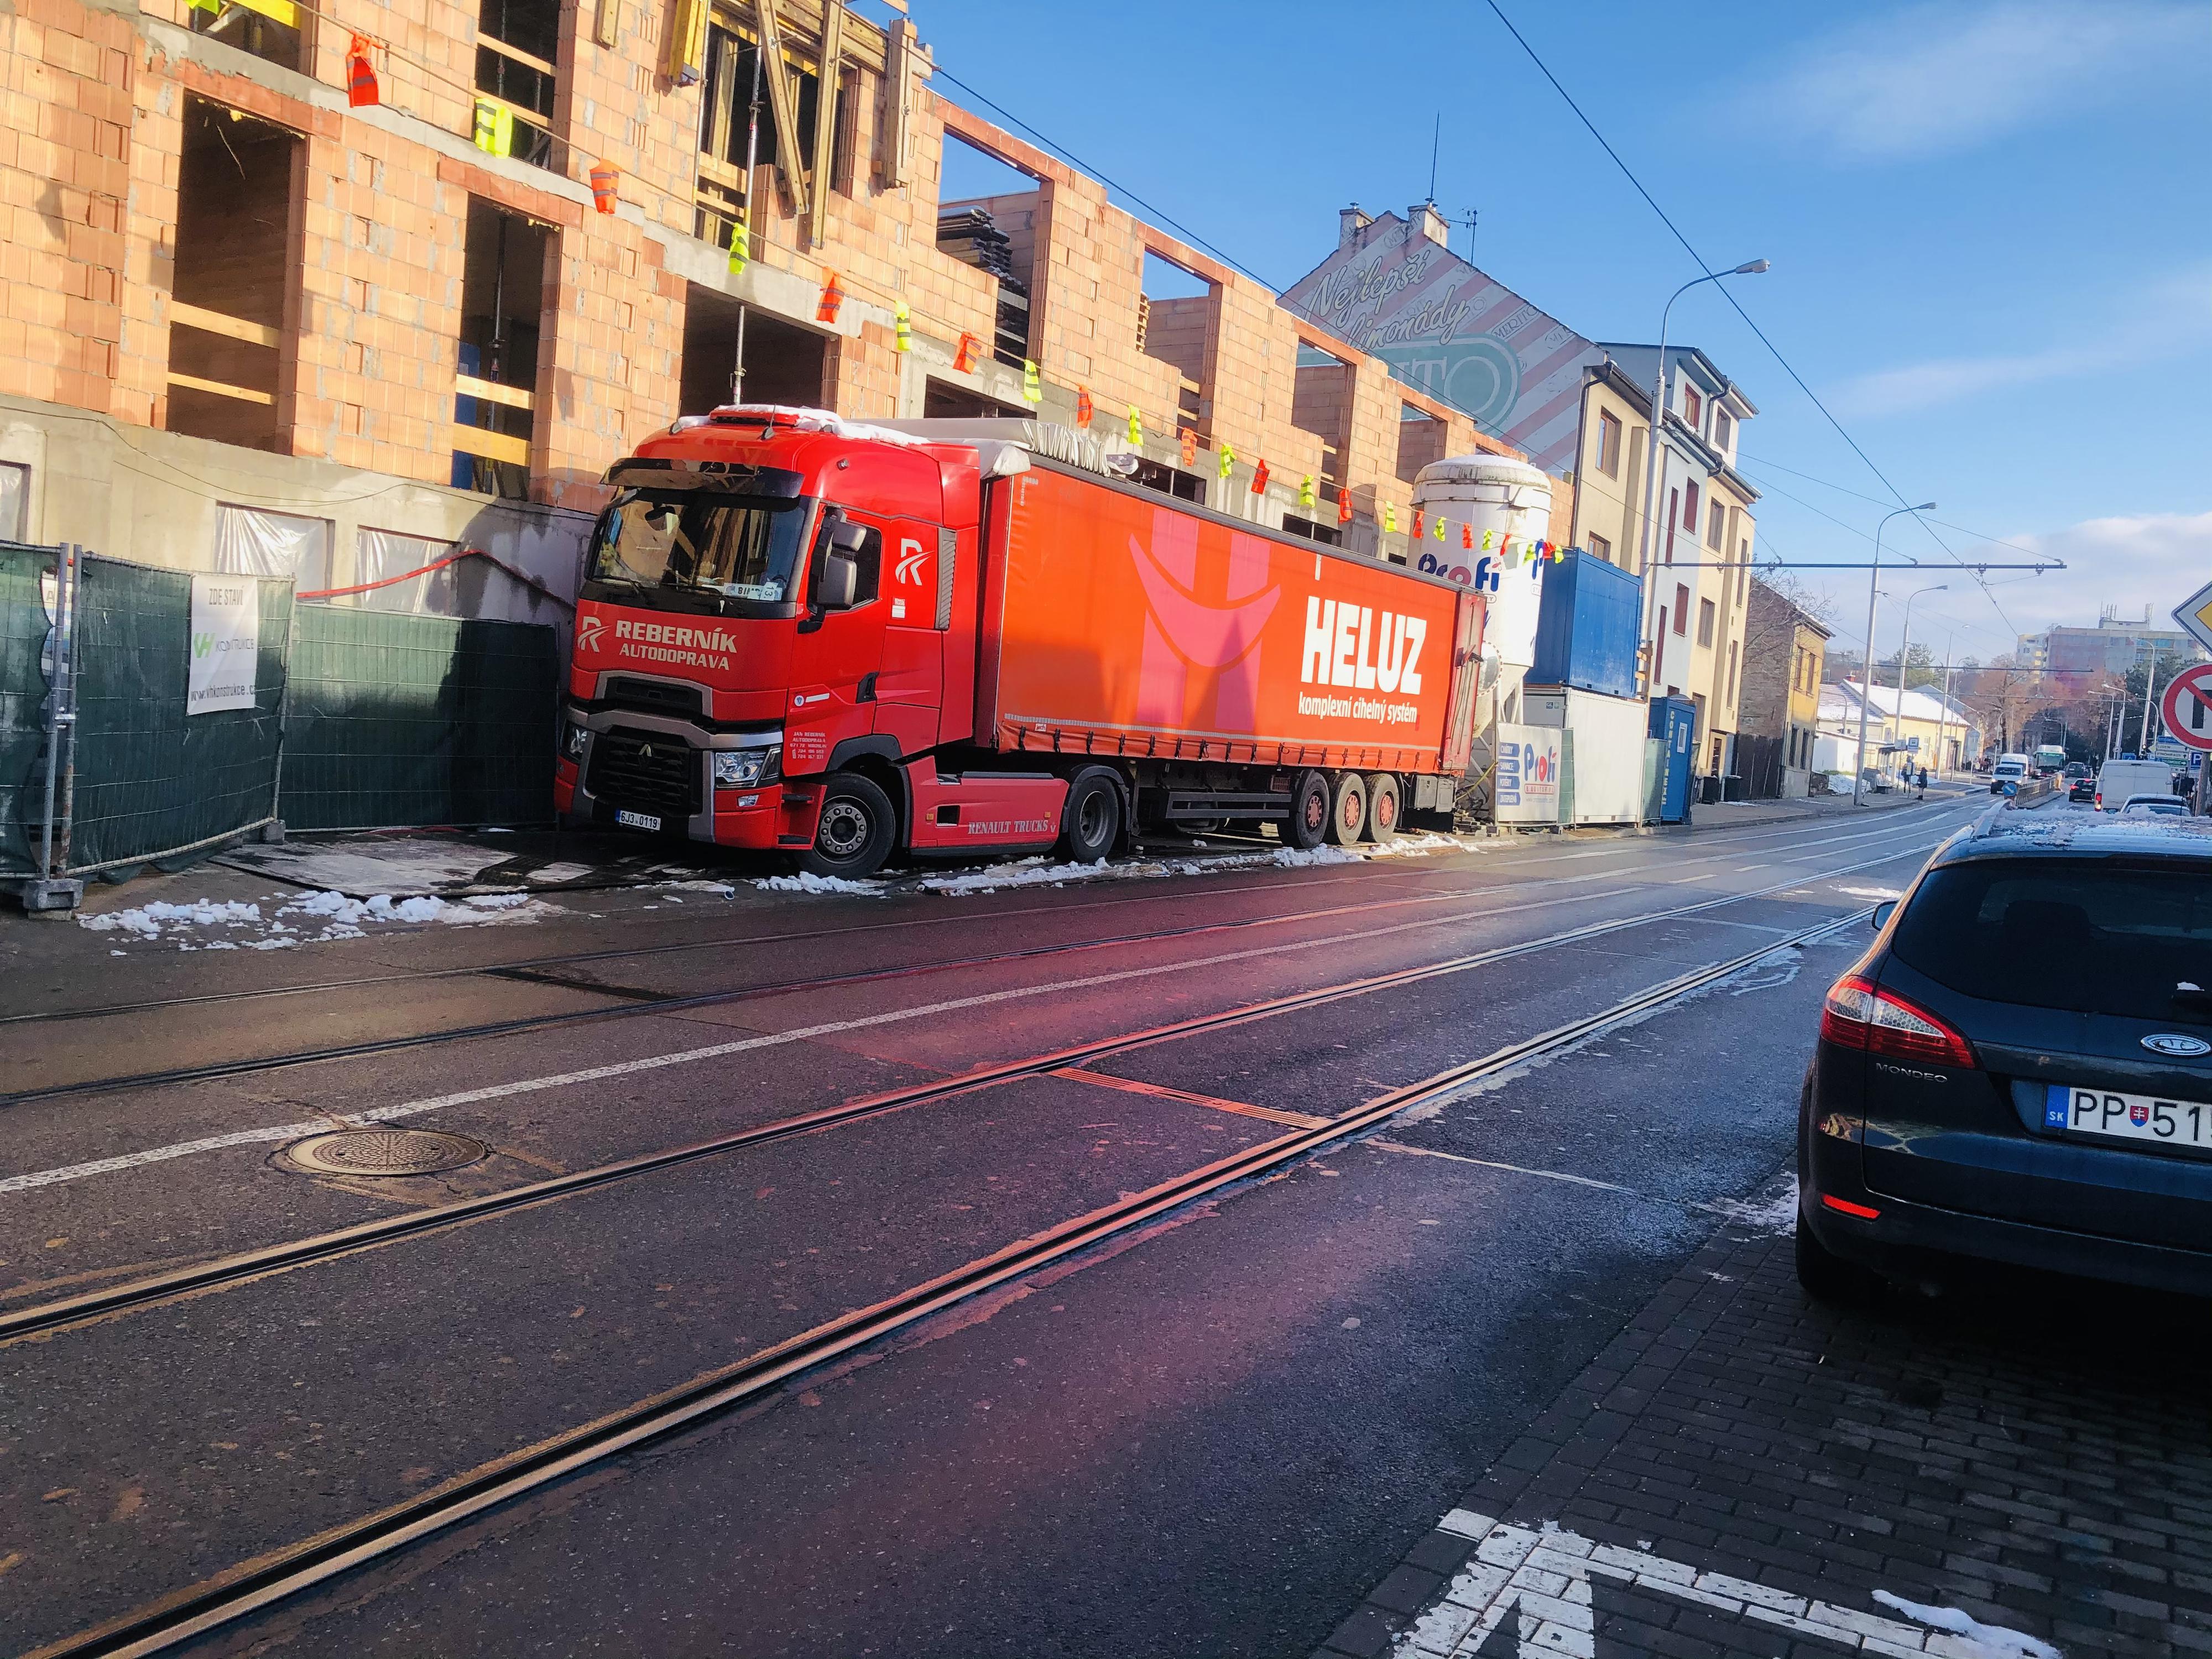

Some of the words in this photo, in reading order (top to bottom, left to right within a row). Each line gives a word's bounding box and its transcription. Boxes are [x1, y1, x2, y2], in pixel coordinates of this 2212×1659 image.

[1303, 249, 1431, 328] Nejlepší
[1345, 284, 1470, 352] limonády
[1494, 305, 1540, 338] MERITO
[209, 588, 222, 605] ZDE
[225, 586, 243, 606] STAVÍ
[615, 620, 737, 653] REBERNÍK
[1301, 596, 1427, 695] HELUZ
[619, 643, 729, 670] AUTODOPRAVA
[1298, 691, 1353, 720] komplexní
[1353, 697, 1386, 724] cihelný
[1387, 702, 1417, 725] systém
[621, 812, 634, 823] 6J3
[639, 816, 658, 828] 0119
[968, 821, 1011, 834] RENAULT
[1014, 820, 1048, 833] TRUCKS
[1876, 1063, 1947, 1083] MONDEO
[2049, 1111, 2064, 1122] SK
[2074, 1091, 2126, 1129] PP
[2153, 1101, 2212, 1142] 51
